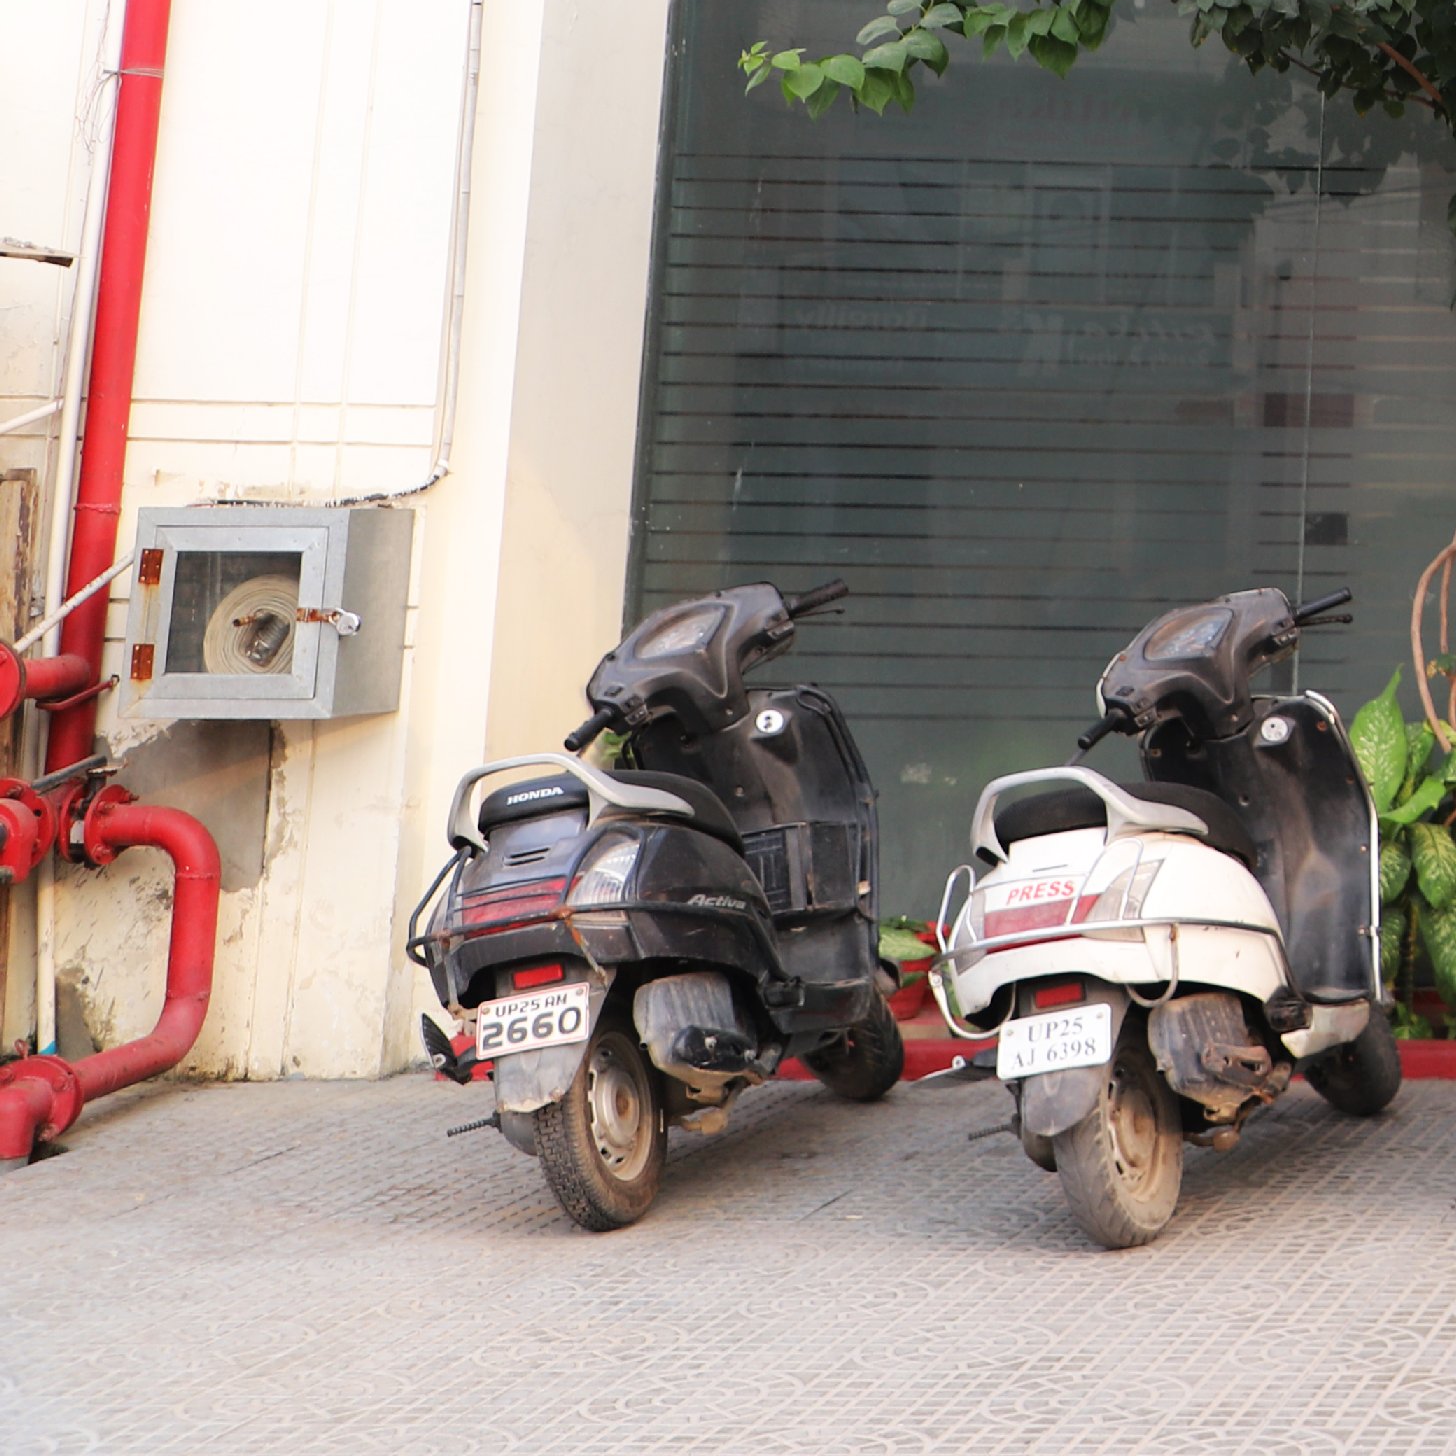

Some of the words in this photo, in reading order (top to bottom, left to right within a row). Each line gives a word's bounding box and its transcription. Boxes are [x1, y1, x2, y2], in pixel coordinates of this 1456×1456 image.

[507, 787, 564, 805] HONDA
[688, 894, 746, 909] Activa
[1006, 880, 1075, 905] PRESS
[495, 999, 540, 1017] UP25
[483, 1006, 581, 1051] 2660
[1028, 1017, 1083, 1042] UP25
[1012, 1048, 1035, 1069] AJ
[1046, 1038, 1096, 1062] 6398
